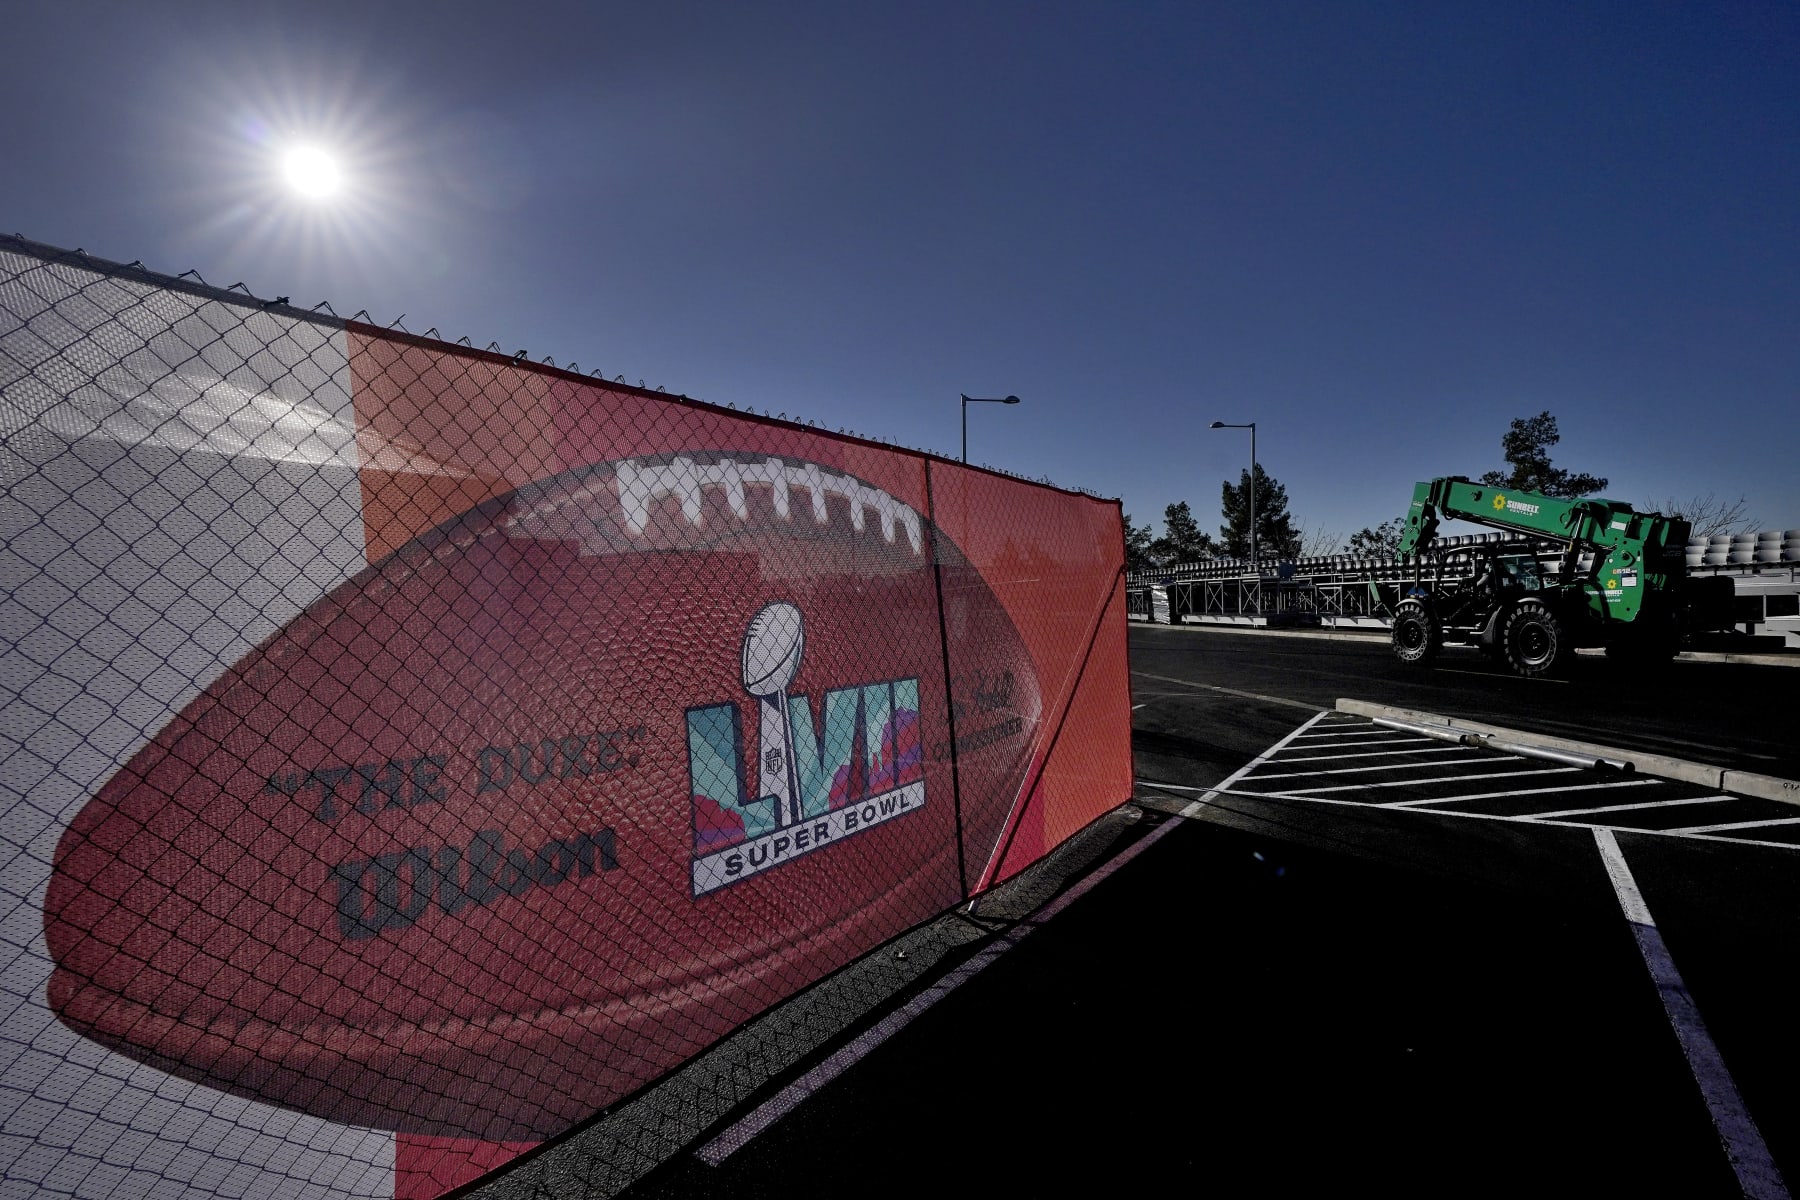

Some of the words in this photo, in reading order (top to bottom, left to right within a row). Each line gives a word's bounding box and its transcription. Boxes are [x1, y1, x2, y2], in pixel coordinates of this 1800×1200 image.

[1506, 500, 1540, 514] SUNBELT
[767, 759, 782, 773] NFL
[725, 823, 830, 876] SUPER
[844, 791, 911, 829] BOWL
[330, 826, 618, 941] Wilson
